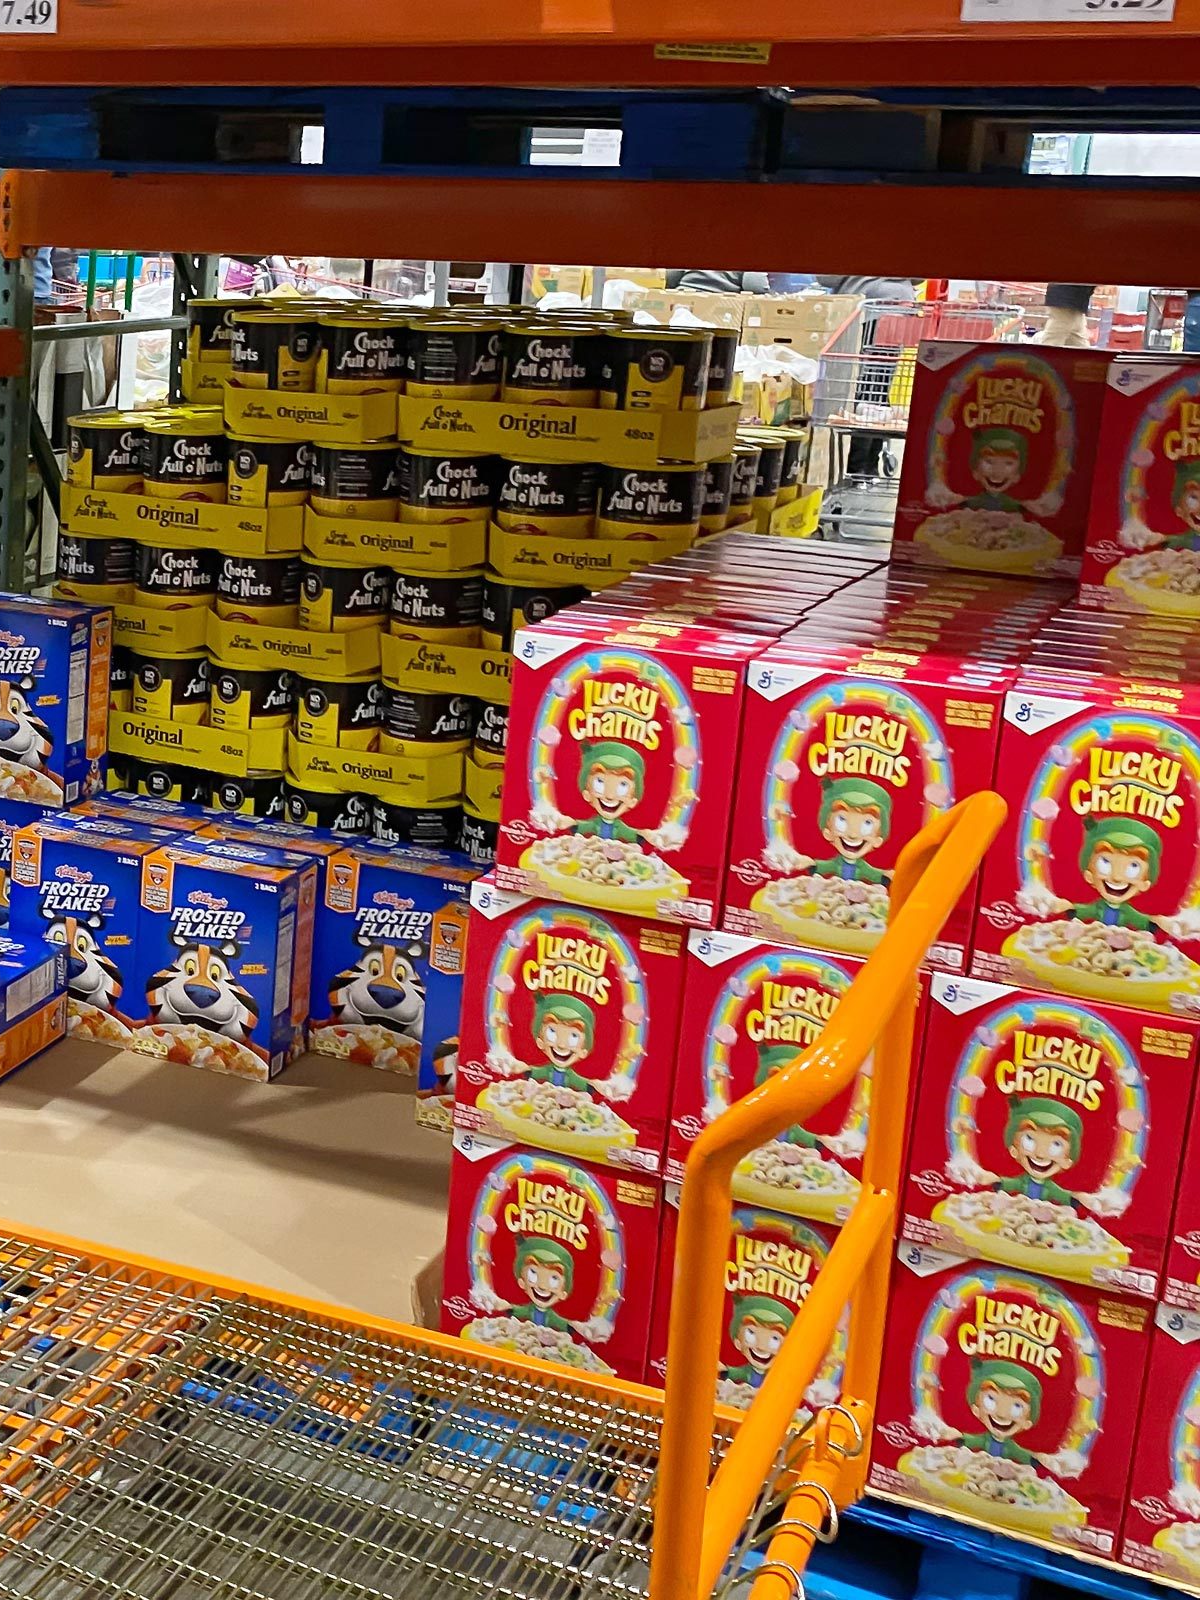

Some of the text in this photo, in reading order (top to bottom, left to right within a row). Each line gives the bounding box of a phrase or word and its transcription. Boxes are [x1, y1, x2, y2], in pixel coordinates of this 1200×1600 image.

[2, 0, 52, 25] 7.49
[353, 331, 395, 353] Chock
[528, 338, 571, 361] Chock
[336, 350, 365, 371] full
[512, 358, 538, 379] full
[976, 377, 1044, 409] Lucky
[276, 406, 329, 424] Original
[433, 405, 463, 420] Chock
[962, 401, 1045, 434] Charms
[499, 413, 655, 442] Original 48oz
[104, 449, 130, 469] full
[173, 439, 212, 460] Chock
[158, 456, 184, 475] full
[436, 460, 478, 483] Chock
[508, 465, 548, 487] Chock
[419, 478, 448, 499] full
[623, 473, 668, 495] Chock
[607, 491, 633, 511] full
[136, 504, 263, 533] Original 48oz
[360, 533, 414, 552] Original
[161, 552, 199, 572] Chock
[223, 559, 256, 579] Chock
[553, 551, 612, 569] Original
[148, 568, 170, 586] full
[345, 589, 372, 609] full
[396, 578, 430, 599] Chock
[113, 613, 146, 632] iginal
[262, 639, 313, 656] Original
[417, 645, 446, 663] Chock
[263, 690, 287, 709] full
[584, 679, 659, 721] Lucky
[351, 703, 376, 723] full
[431, 715, 458, 735] full
[568, 709, 663, 751] Charms
[825, 712, 909, 755] Lucky
[123, 721, 244, 757] Original 48oz
[342, 762, 393, 780] Original
[808, 741, 911, 787] Charms
[1089, 747, 1182, 794] Lucky
[1069, 779, 1185, 828] Charms
[331, 813, 355, 832] full
[39, 881, 110, 898] FROSTED
[42, 895, 103, 912] FLAKES
[170, 907, 246, 926] FROSTED
[355, 907, 433, 926] FROSTED
[173, 922, 238, 940] FLAKES
[358, 922, 425, 940] FLAKES
[536, 933, 608, 973] Lucky
[522, 960, 612, 1006] Charms
[745, 1012, 825, 1044] Charm
[1013, 1030, 1102, 1080] Lucky
[995, 1059, 1105, 1112] Charms
[517, 1177, 586, 1223] Lucky
[504, 1202, 591, 1251] Charms
[735, 1234, 812, 1278] Lucky
[975, 1295, 1060, 1347] Lucky
[957, 1322, 1063, 1377] Charms
